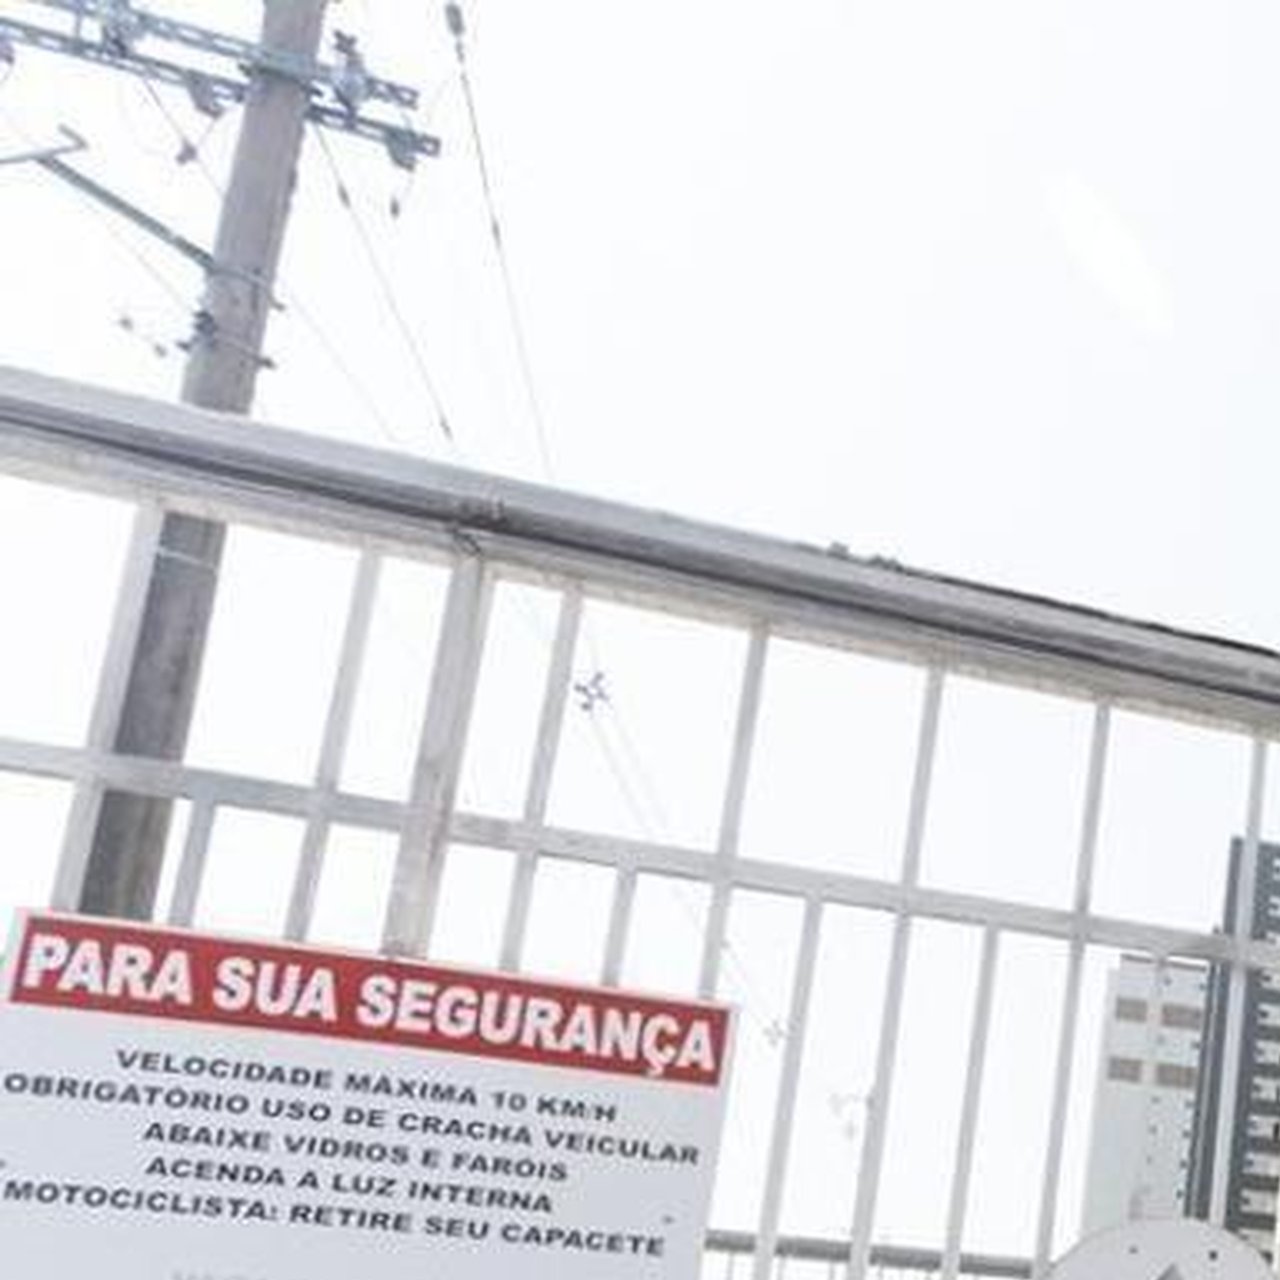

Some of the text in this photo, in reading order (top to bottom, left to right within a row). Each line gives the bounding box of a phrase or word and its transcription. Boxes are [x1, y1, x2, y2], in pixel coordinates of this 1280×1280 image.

[21, 931, 717, 1076] PARA SUA SEGURANÇA
[116, 1049, 333, 1091] VELOCIDADE
[490, 1091, 528, 1112] 10
[143, 1121, 273, 1151] ABAIXE
[284, 1135, 410, 1167] VIDROS
[420, 1147, 440, 1169] E
[261, 1097, 332, 1123] USO
[342, 1105, 387, 1129] DE
[545, 1128, 701, 1165] VEICULAR
[145, 1156, 554, 1214] ACENDA A LUZ INTERNA
[2, 1180, 665, 1257] MOTOCICLISTA: RETIRE SEU CAPACETE
